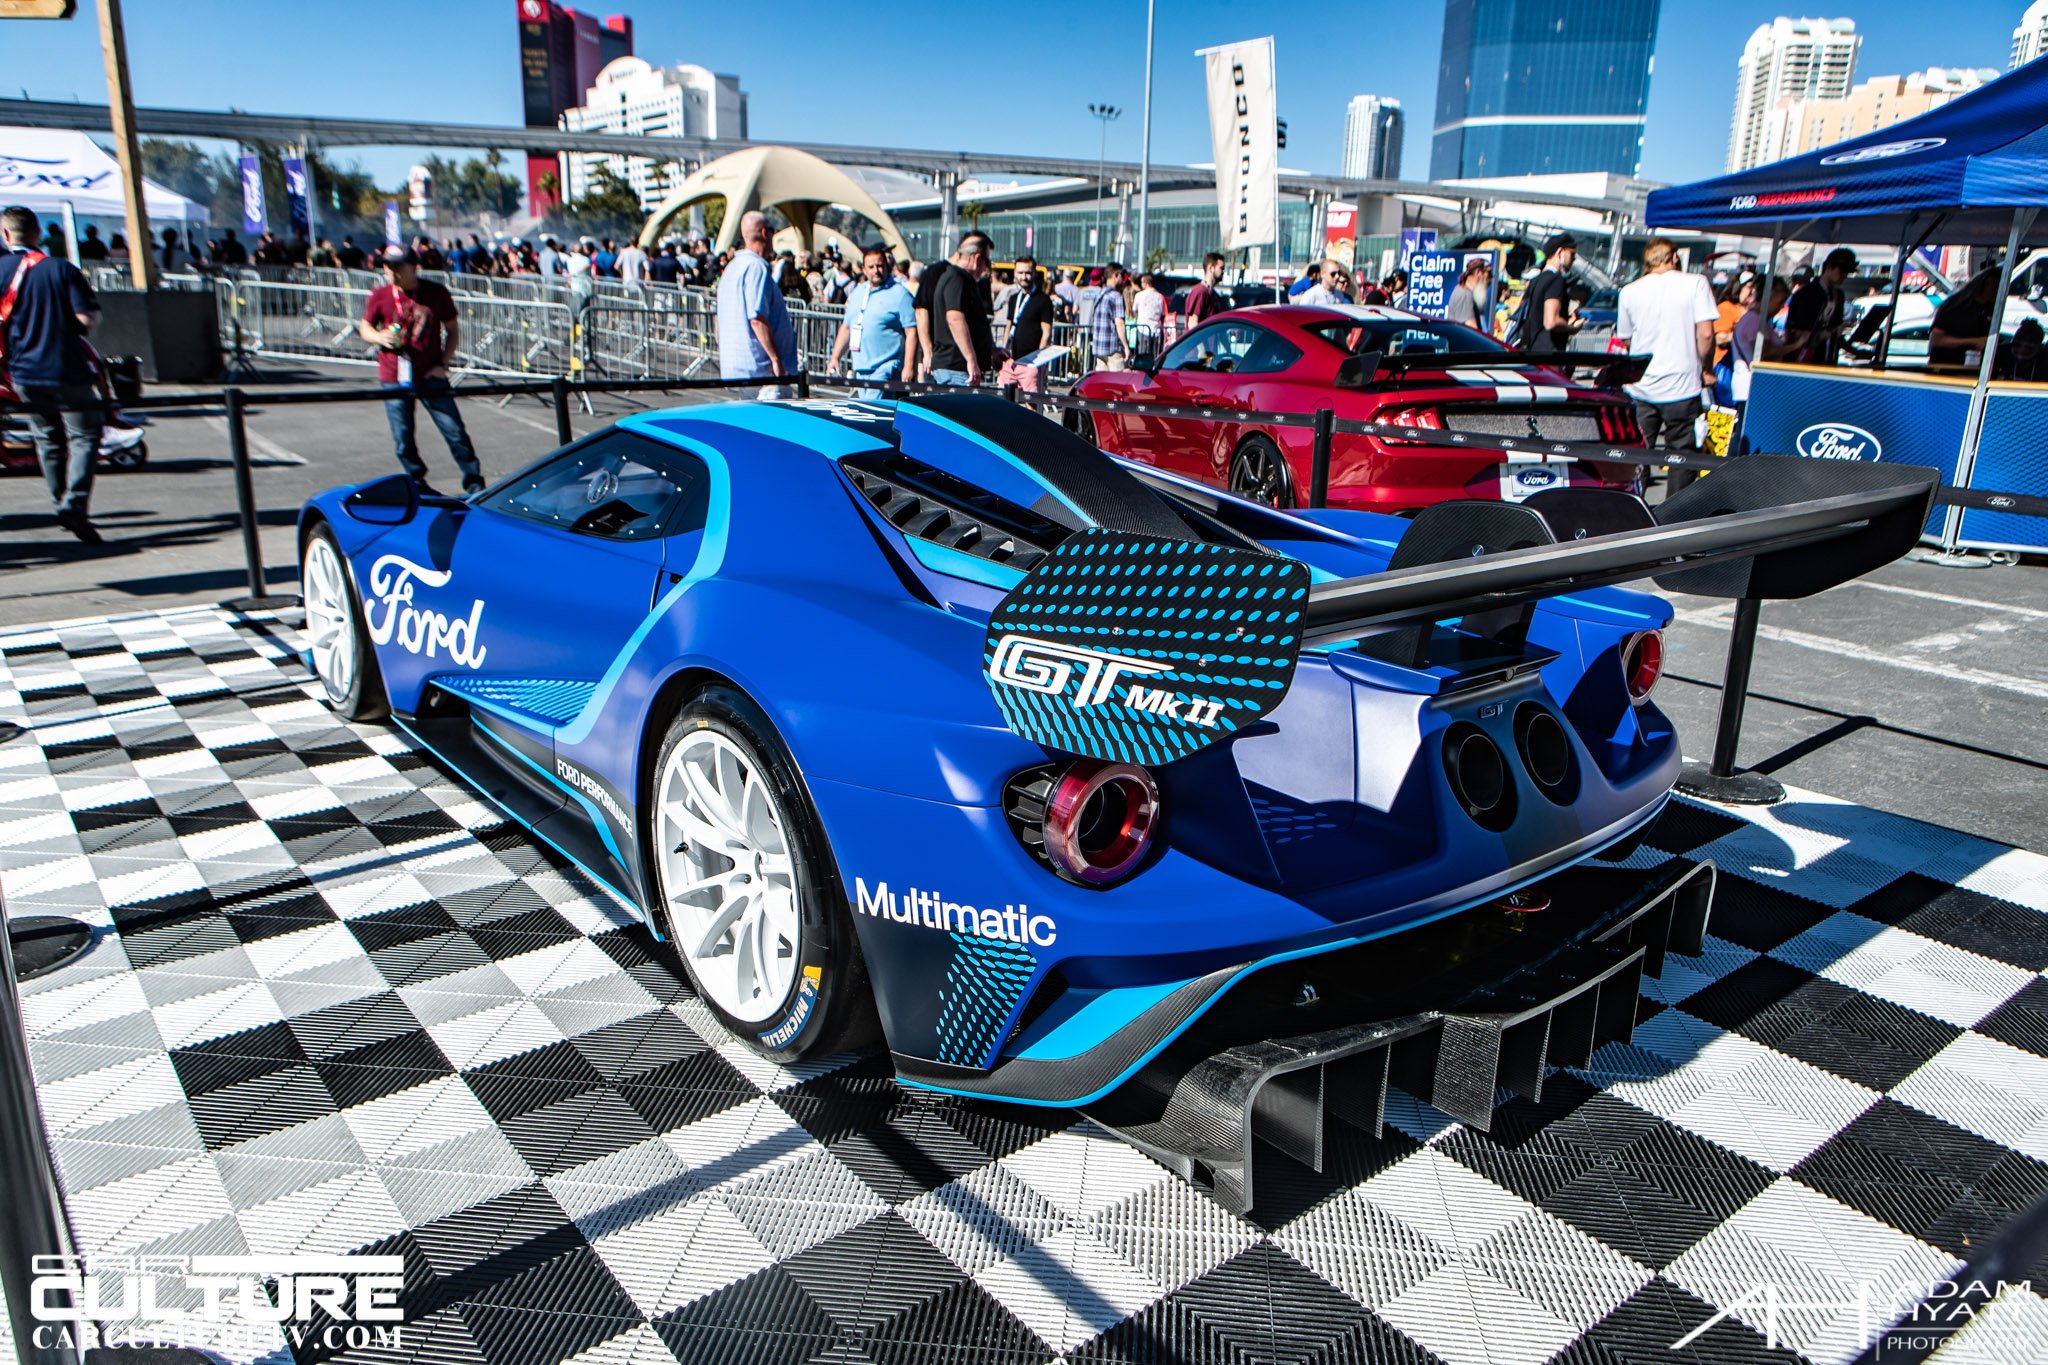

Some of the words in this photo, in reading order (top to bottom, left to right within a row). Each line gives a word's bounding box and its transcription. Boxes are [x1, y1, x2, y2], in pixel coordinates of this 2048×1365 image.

[1232, 63, 1252, 233] BRONCO
[1729, 195, 1758, 210] FORD
[1756, 187, 1836, 207] PERFORMANCE
[1410, 272, 1444, 289] Free
[1411, 254, 1456, 272] Claim
[1409, 288, 1444, 306] Ford
[1810, 427, 1863, 463] Ford
[1523, 472, 1550, 485] Ford
[364, 554, 487, 670] Ford
[990, 634, 1175, 708] GT
[557, 758, 580, 787] FORD
[580, 772, 633, 839] PERFORMANCE
[855, 877, 1057, 947] Multimatic
[762, 996, 809, 1048] MICHELIN
